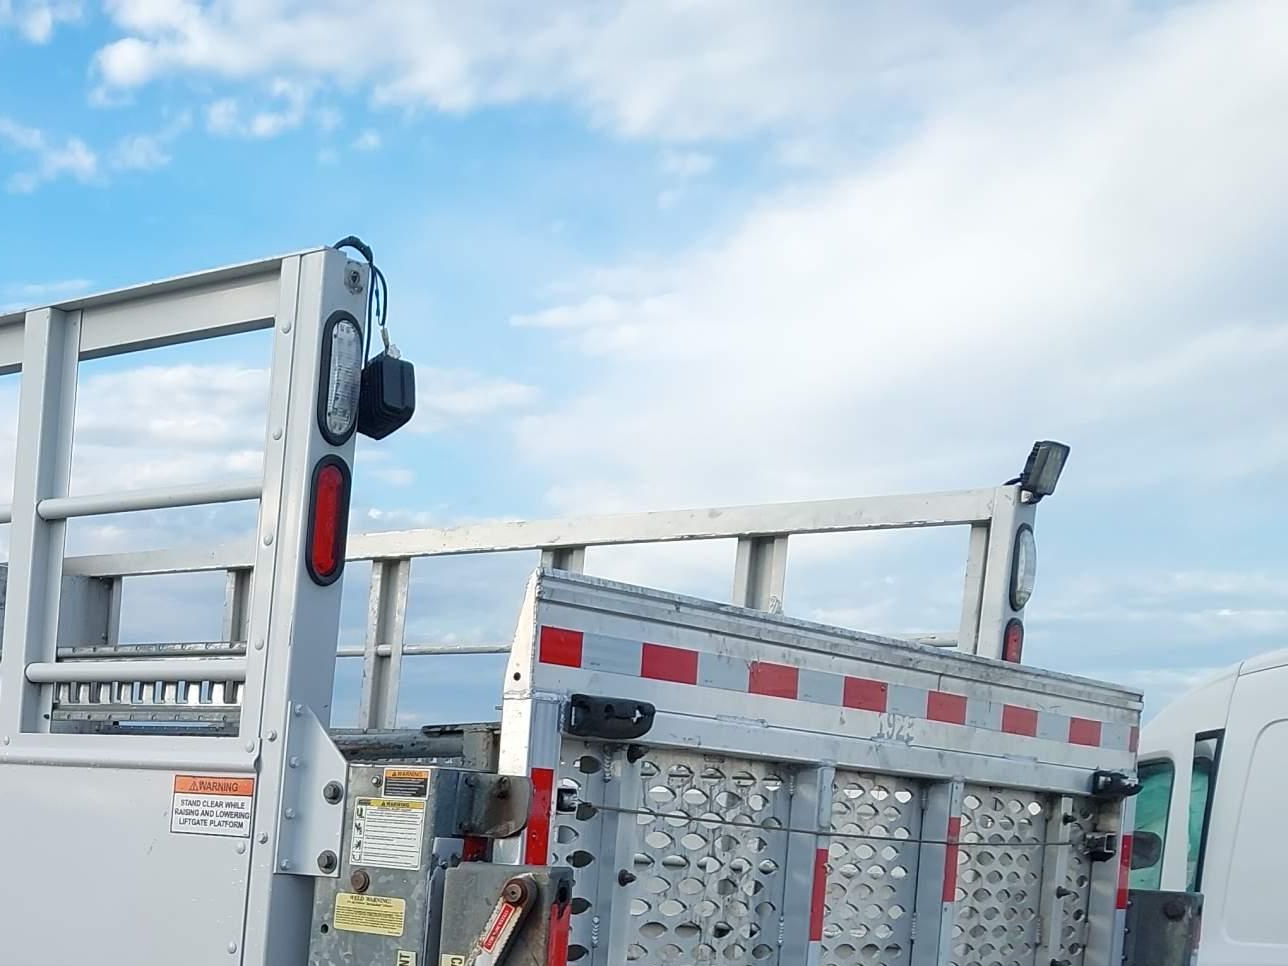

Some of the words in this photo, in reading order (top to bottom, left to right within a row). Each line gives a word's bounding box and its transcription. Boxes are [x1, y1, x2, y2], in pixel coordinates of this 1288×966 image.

[199, 780, 239, 792] WARNING
[181, 799, 201, 807] STAND
[202, 800, 224, 808] CLEAR
[225, 801, 246, 809] WHILE
[174, 808, 199, 816] RAISING
[200, 809, 215, 817] AND
[215, 811, 250, 819] LOWERING
[178, 817, 208, 826] LIFTGATE
[209, 819, 244, 828] PLATFORM
